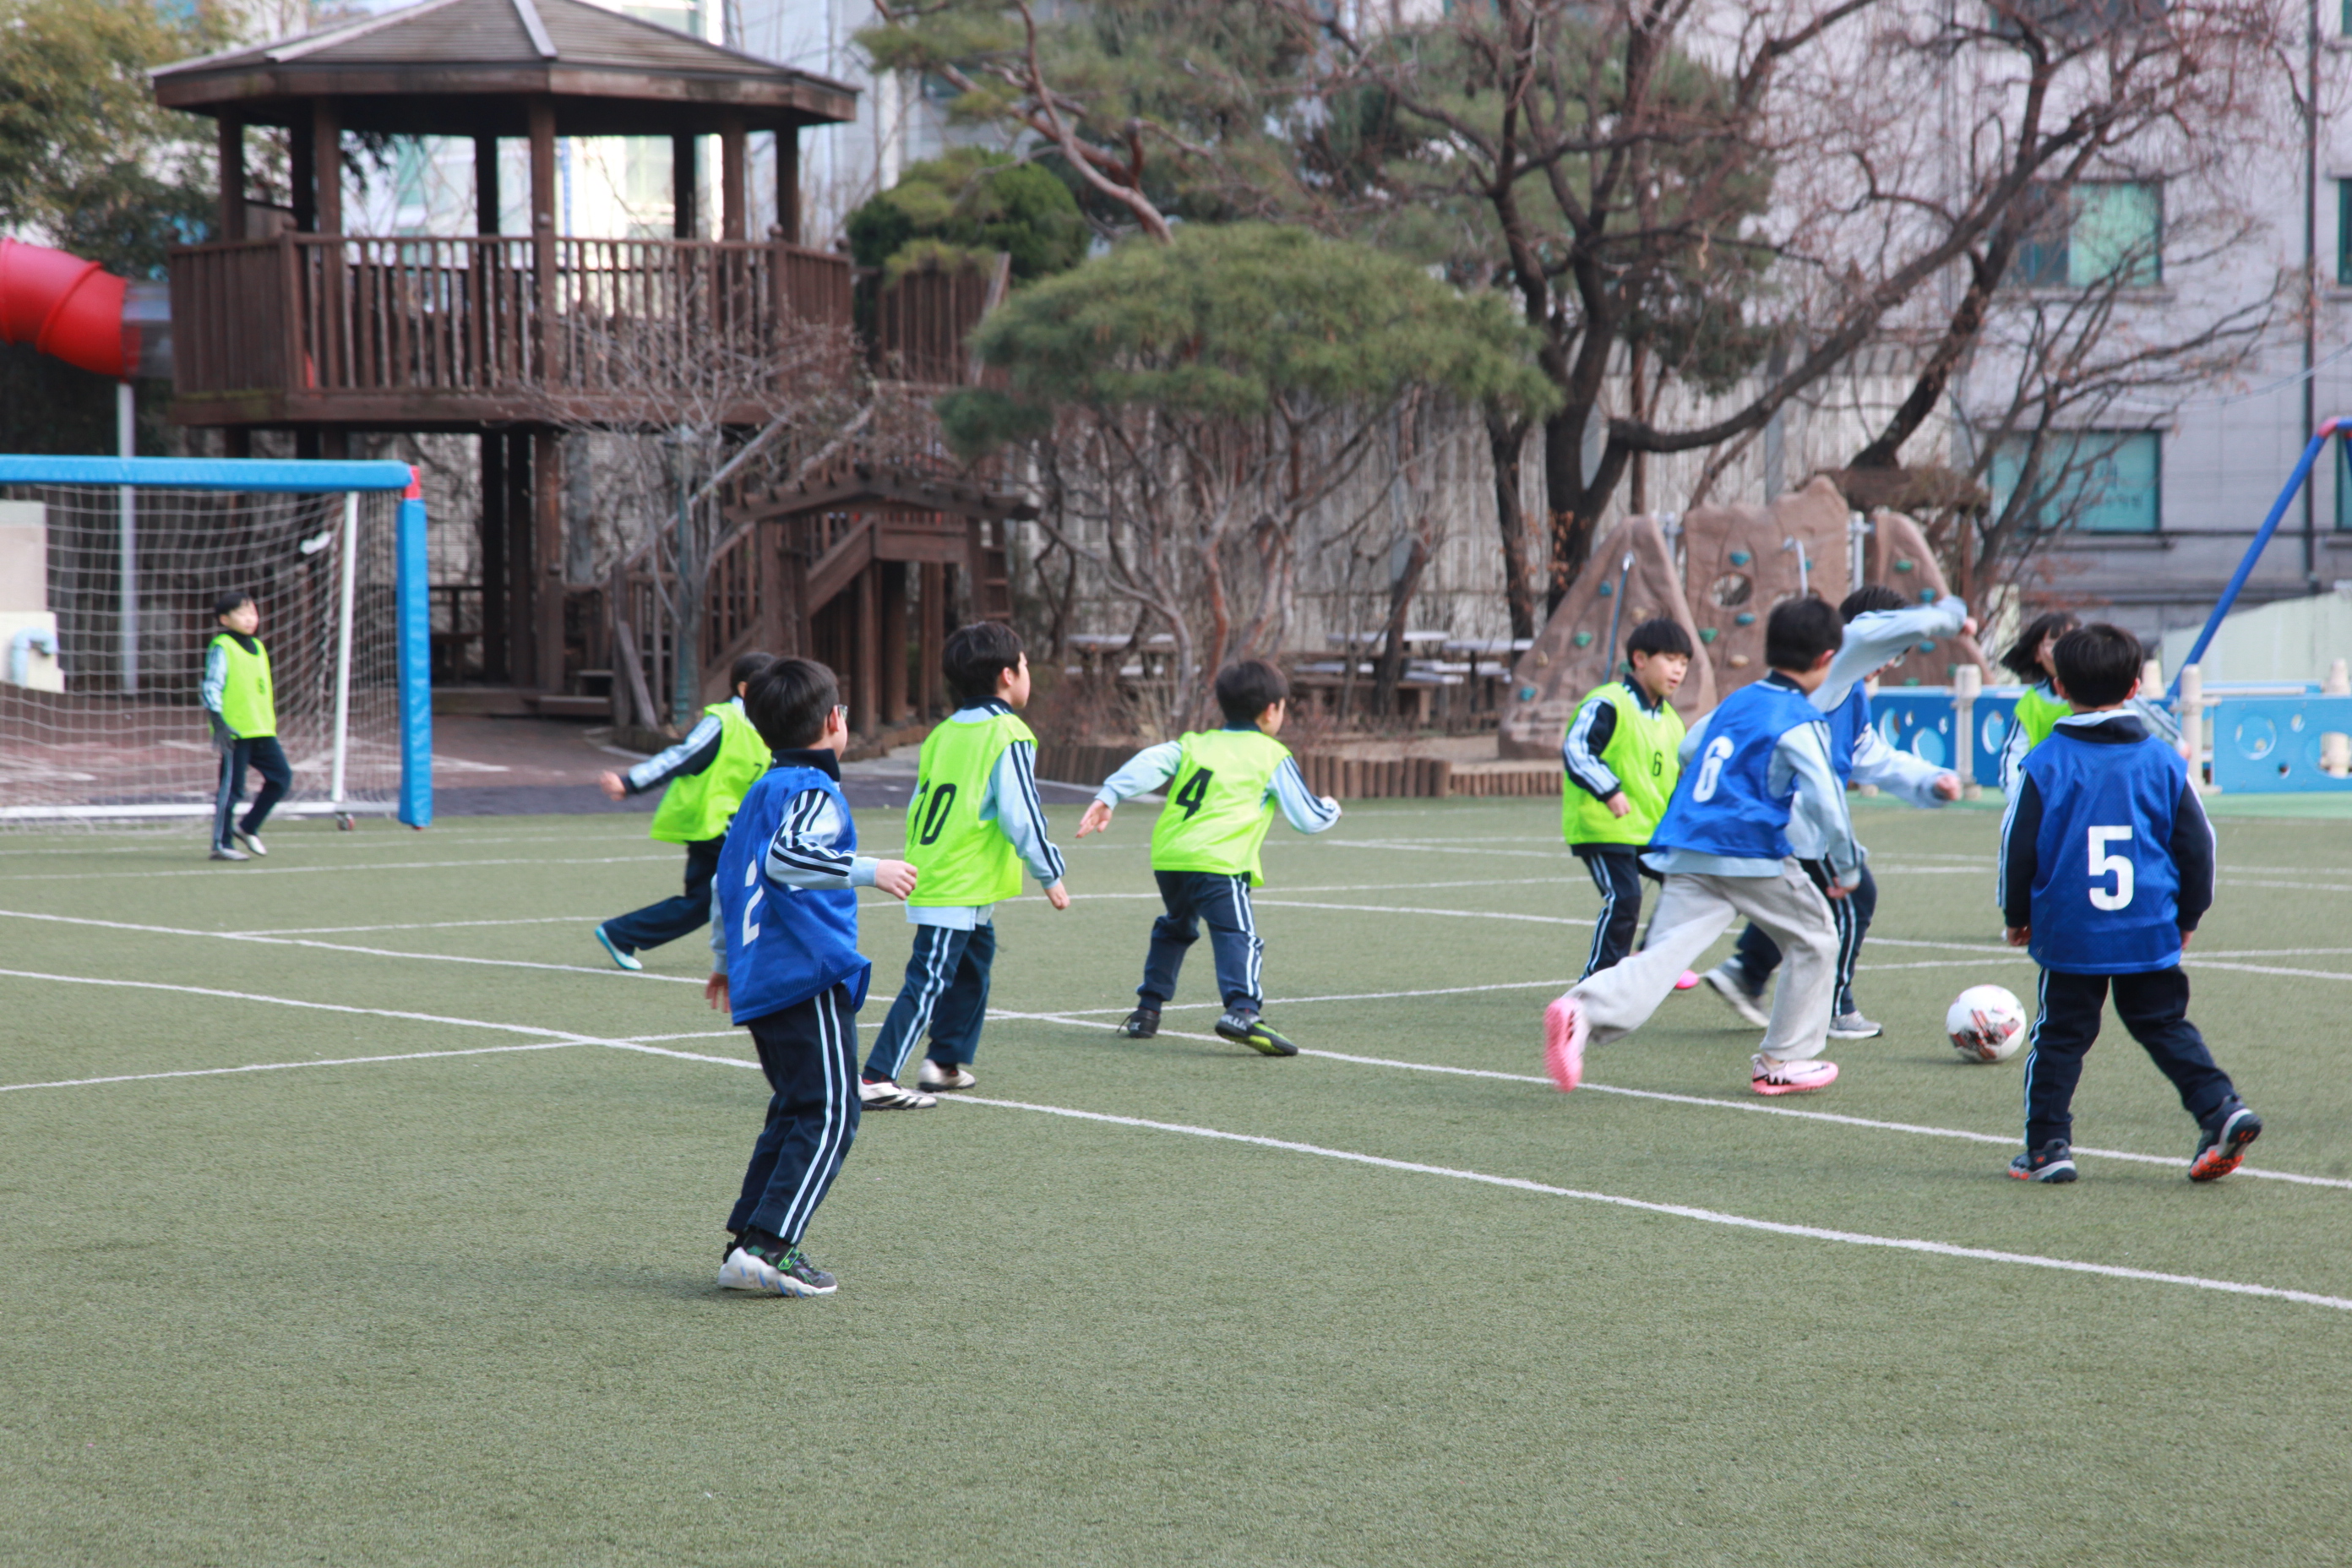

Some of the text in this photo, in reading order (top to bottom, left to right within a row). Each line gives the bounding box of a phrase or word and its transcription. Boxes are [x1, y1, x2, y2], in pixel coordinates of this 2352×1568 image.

[1175, 766, 1213, 822] 4
[1652, 751, 1663, 777] 6
[1692, 735, 1734, 803] 6
[911, 778, 956, 846] 10
[743, 855, 765, 947] 2
[2088, 825, 2135, 911] 5
